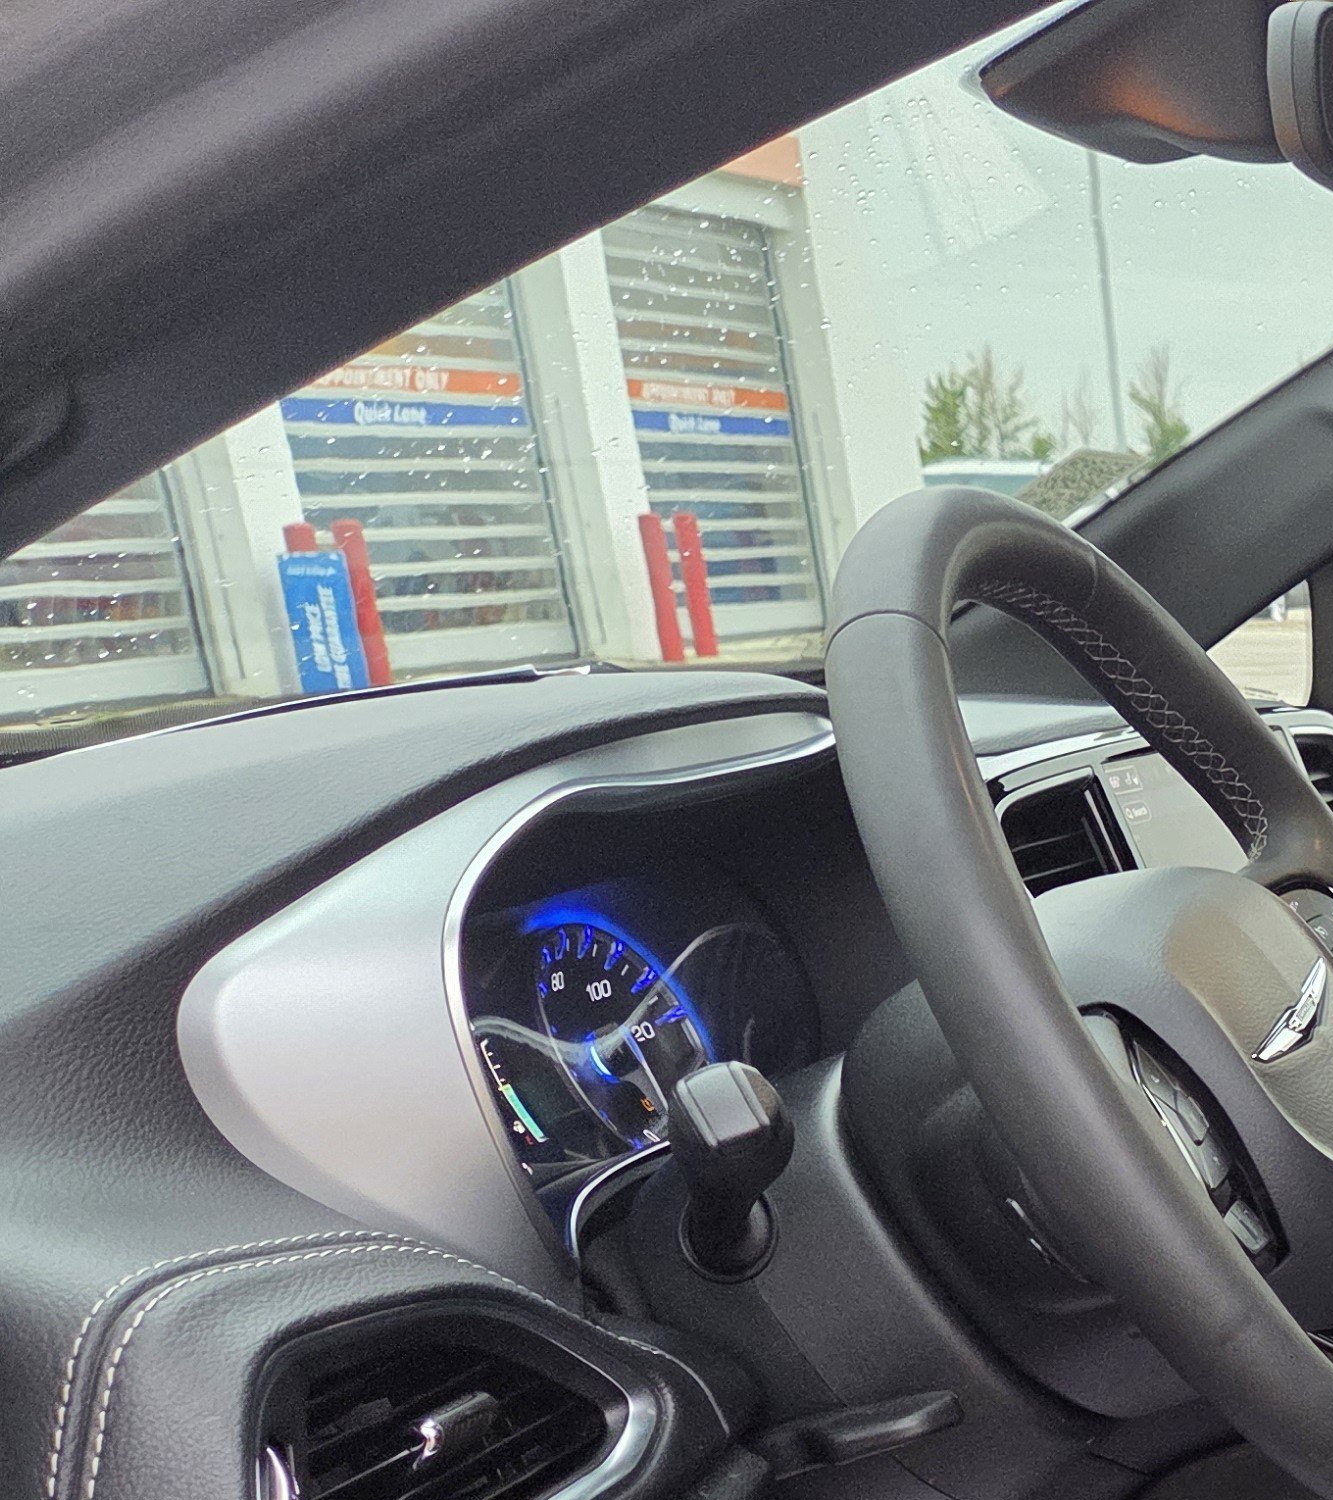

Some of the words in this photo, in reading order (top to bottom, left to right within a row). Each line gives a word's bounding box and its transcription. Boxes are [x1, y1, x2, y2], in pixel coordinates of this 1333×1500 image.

[355, 401, 391, 426] Quick
[394, 405, 428, 426] Lane
[586, 979, 612, 1002] 100
[629, 1020, 656, 1042] 20
